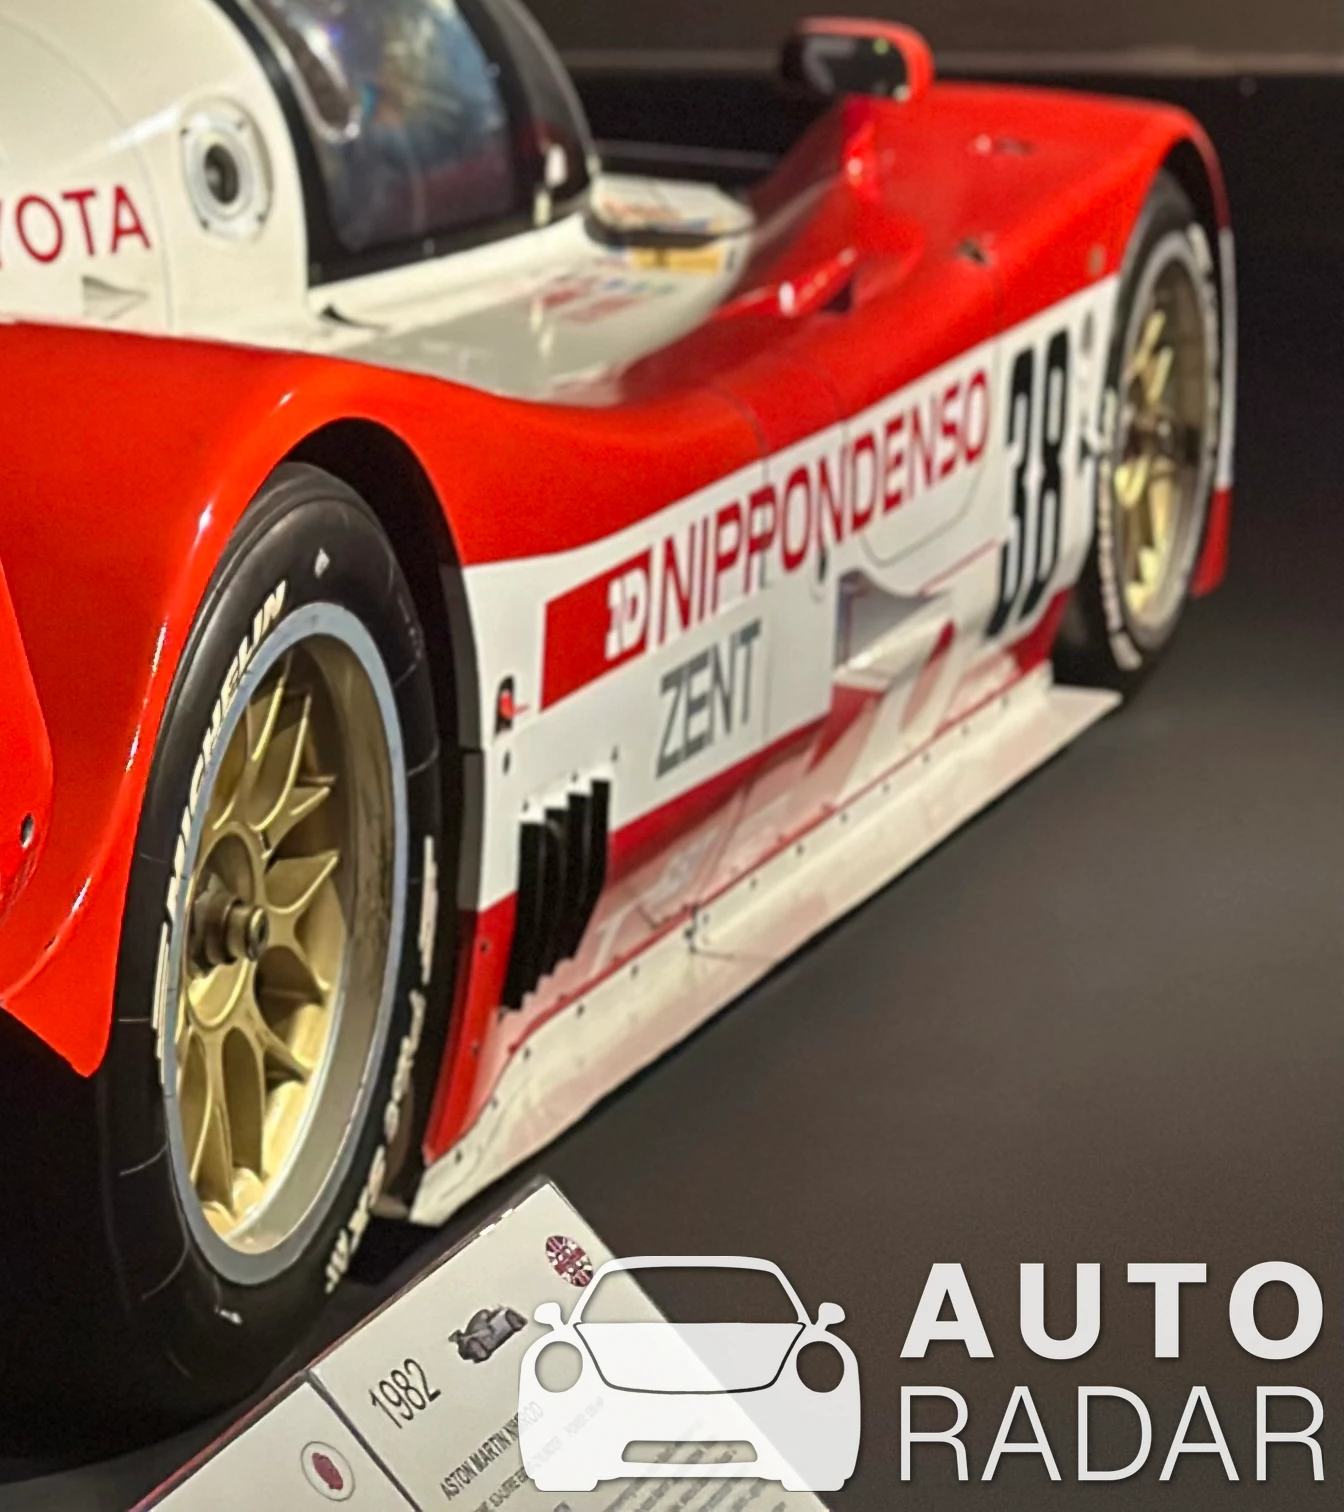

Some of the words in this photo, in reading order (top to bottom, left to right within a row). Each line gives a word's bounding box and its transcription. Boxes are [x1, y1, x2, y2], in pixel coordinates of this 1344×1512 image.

[656, 370, 990, 647] NIPPONDENSO
[984, 326, 1070, 641] 38
[166, 579, 287, 922] MICHELIN
[655, 618, 762, 779] ZENT
[367, 1358, 442, 1429] 1982
[440, 1460, 478, 1501] ASTON
[469, 1429, 513, 1473] MARTIN
